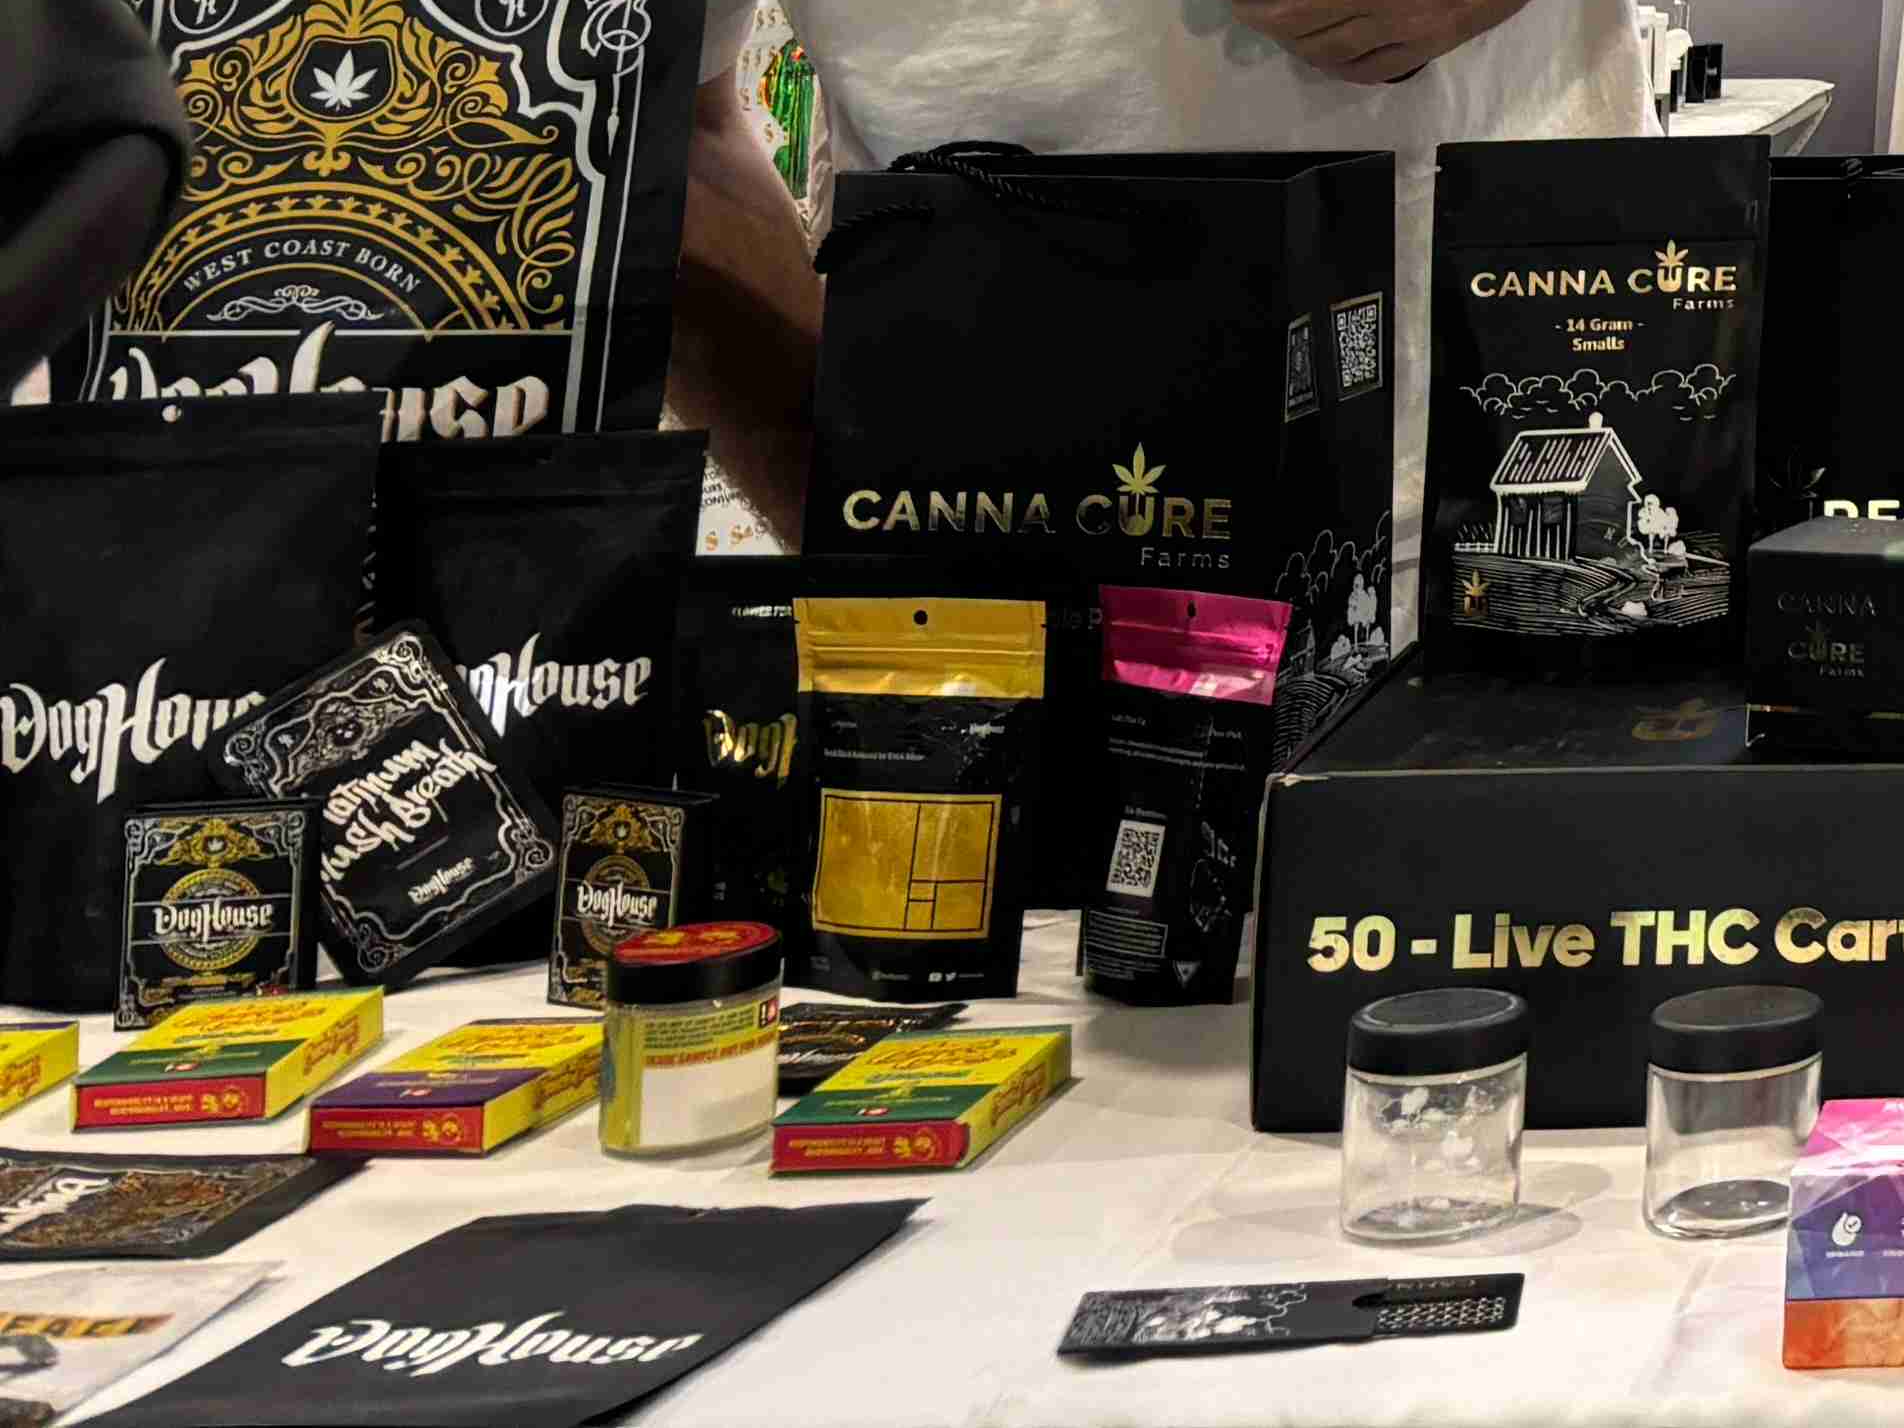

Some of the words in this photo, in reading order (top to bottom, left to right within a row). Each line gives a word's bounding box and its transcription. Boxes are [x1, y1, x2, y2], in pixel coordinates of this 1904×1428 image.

[182, 245, 254, 293] WEST
[263, 238, 353, 260] COAST
[353, 245, 423, 294] BORN
[1470, 269, 1616, 298] CANNA
[1626, 264, 1738, 294] CURE
[1566, 317, 1586, 332] 14
[1589, 317, 1633, 332] Gram
[1672, 297, 1737, 311] Farms
[1571, 336, 1626, 352] Smalls
[842, 489, 1057, 534] CANNA
[1075, 492, 1232, 541] CURE
[1140, 547, 1231, 570] Farms
[455, 631, 653, 739] gHouse
[0, 657, 267, 805] DogHou
[153, 895, 274, 944] DogHouse
[576, 879, 659, 928] DogHouse
[1307, 914, 1397, 974] 50
[1452, 911, 1596, 971] Live
[1610, 907, 1761, 967] THC
